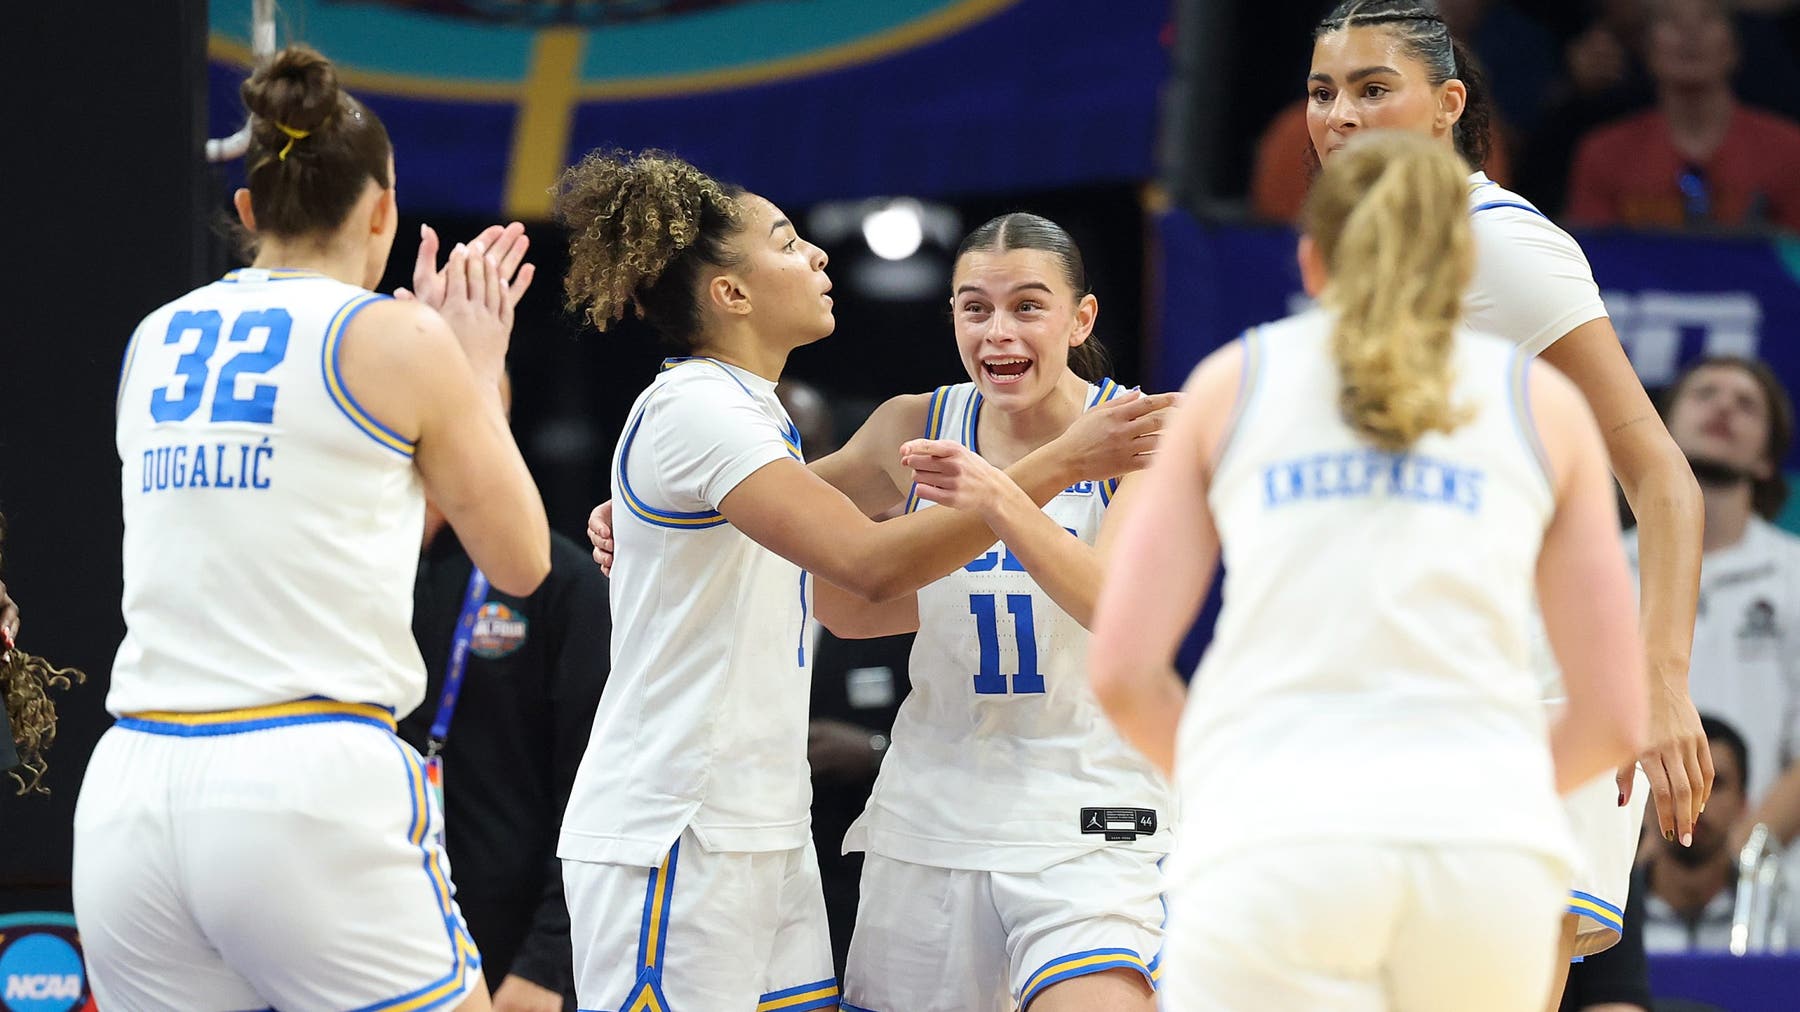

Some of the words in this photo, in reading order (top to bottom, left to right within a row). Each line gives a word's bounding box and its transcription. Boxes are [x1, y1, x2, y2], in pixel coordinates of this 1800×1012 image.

[150, 308, 293, 424] 32
[142, 437, 273, 493] DUGALIĆ
[969, 594, 1045, 694] 11
[1140, 816, 1152, 827] 44
[6, 974, 81, 1000] NCAA
